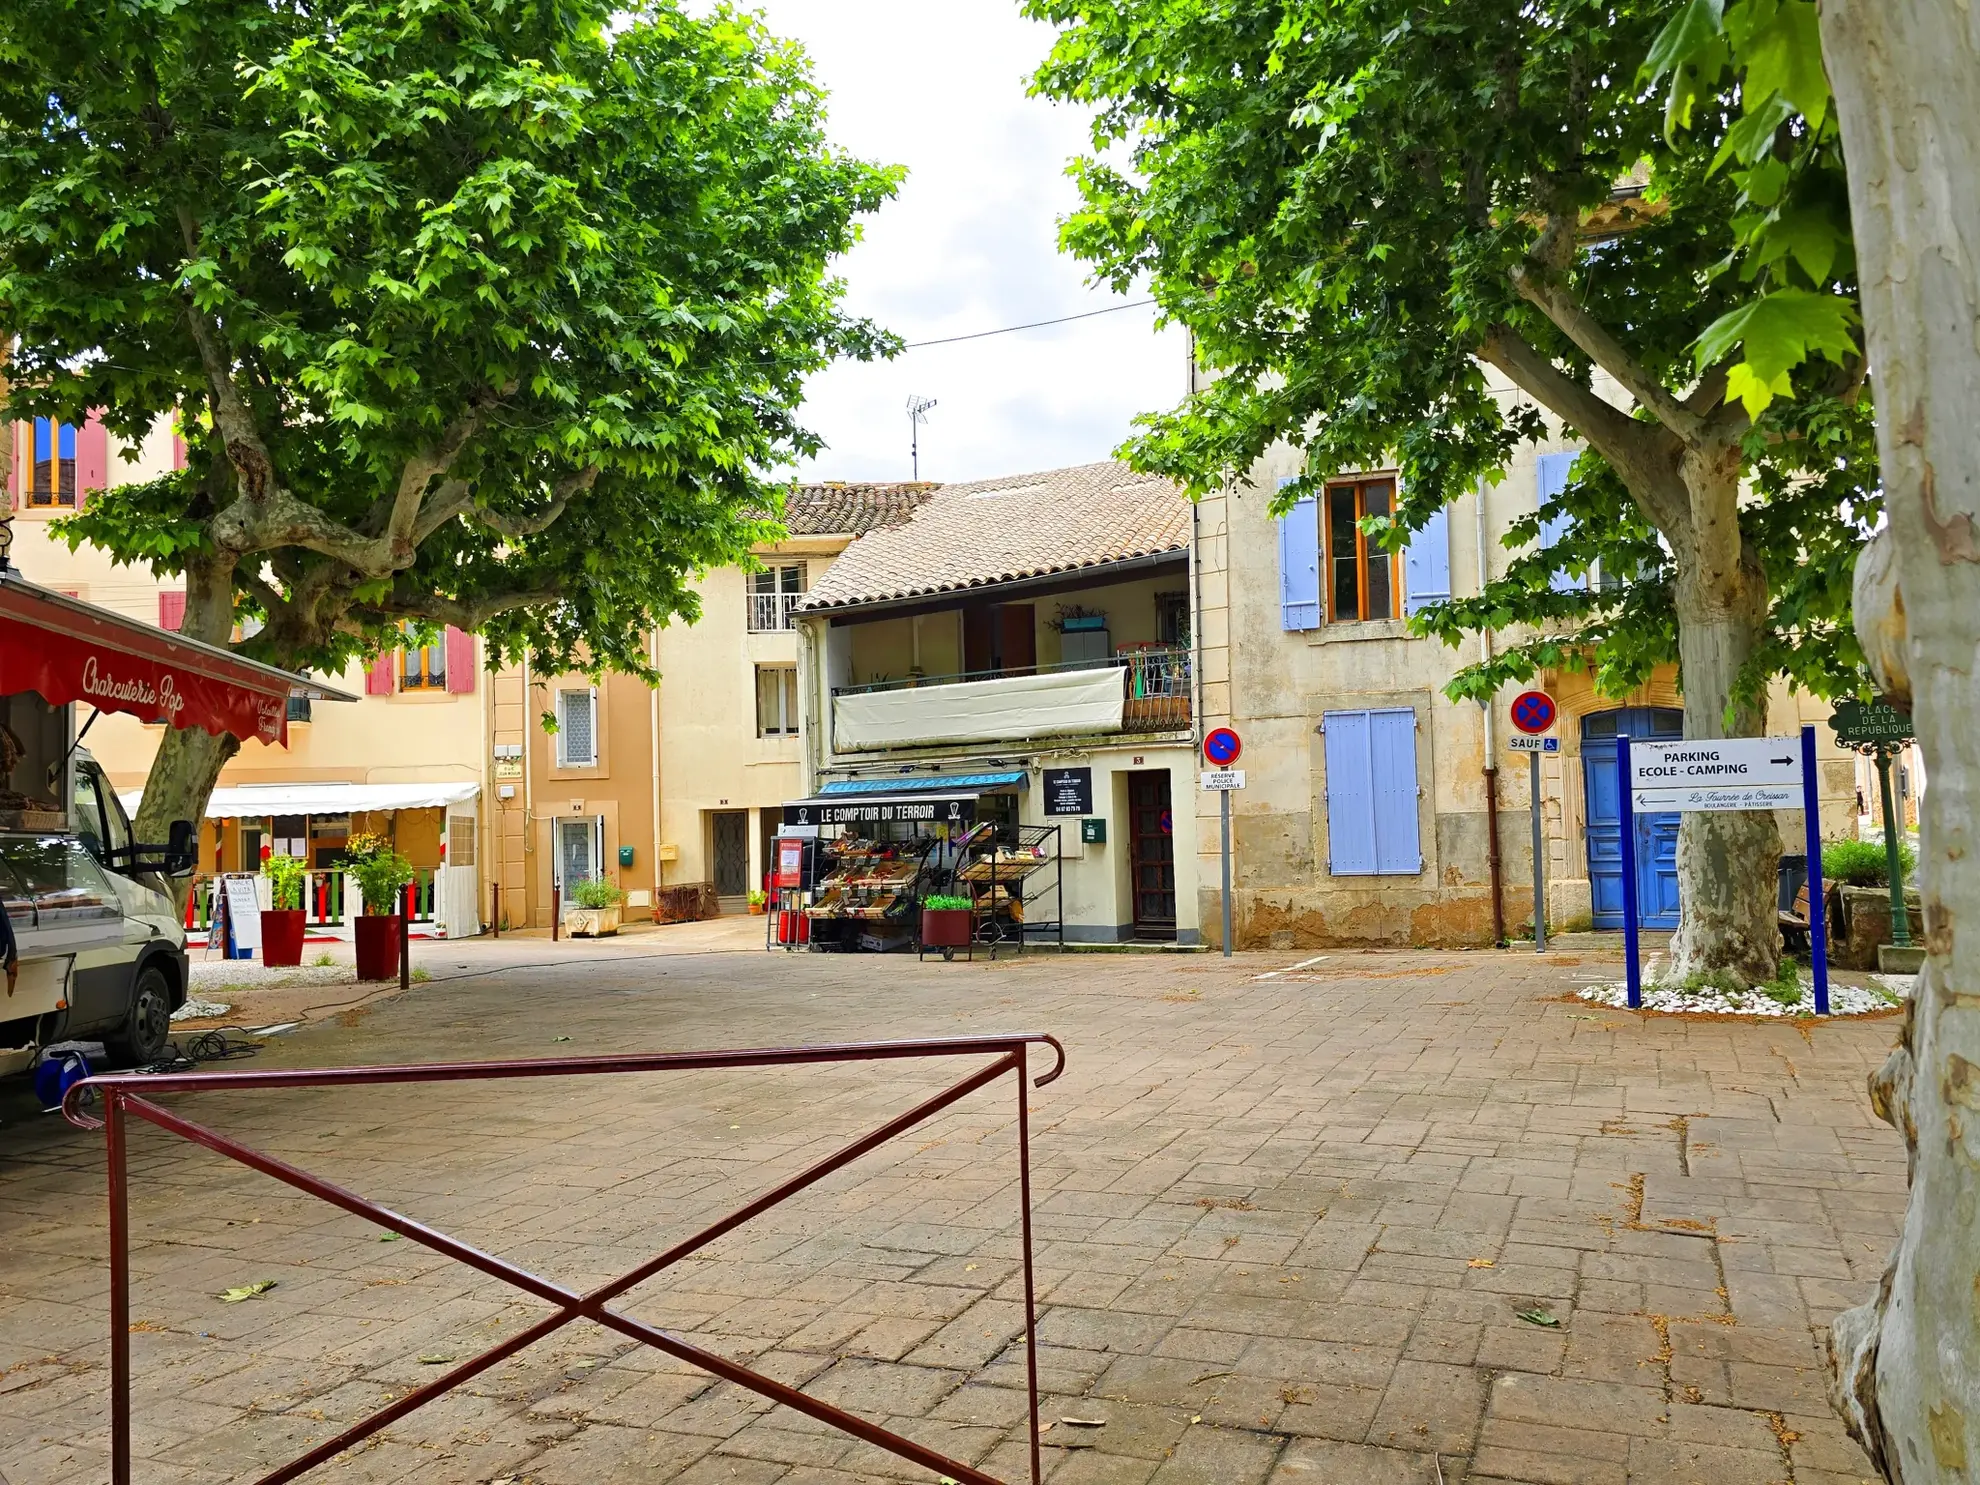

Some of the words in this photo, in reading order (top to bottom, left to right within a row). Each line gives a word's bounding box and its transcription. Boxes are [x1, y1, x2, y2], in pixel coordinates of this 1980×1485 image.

[83, 656, 157, 705] Charcuterie
[159, 674, 185, 717] Pop
[1859, 704, 1897, 715] PLACE
[1862, 715, 1877, 725] DE
[1881, 714, 1896, 724] LA
[1847, 723, 1912, 736] REPUBLIQUE
[1511, 738, 1541, 748] SAUF
[1664, 751, 1720, 763] PARKING
[1639, 766, 1677, 777] ECOLE
[1687, 764, 1748, 775] CAMPING
[1688, 791, 1702, 803] La
[1704, 791, 1740, 802] Fournée
[1742, 792, 1753, 801] de
[1755, 789, 1790, 800] Creissan
[821, 808, 832, 823] LE
[834, 807, 879, 822] COMPTOIR
[881, 806, 893, 820] DU
[896, 805, 935, 820] TERROIR
